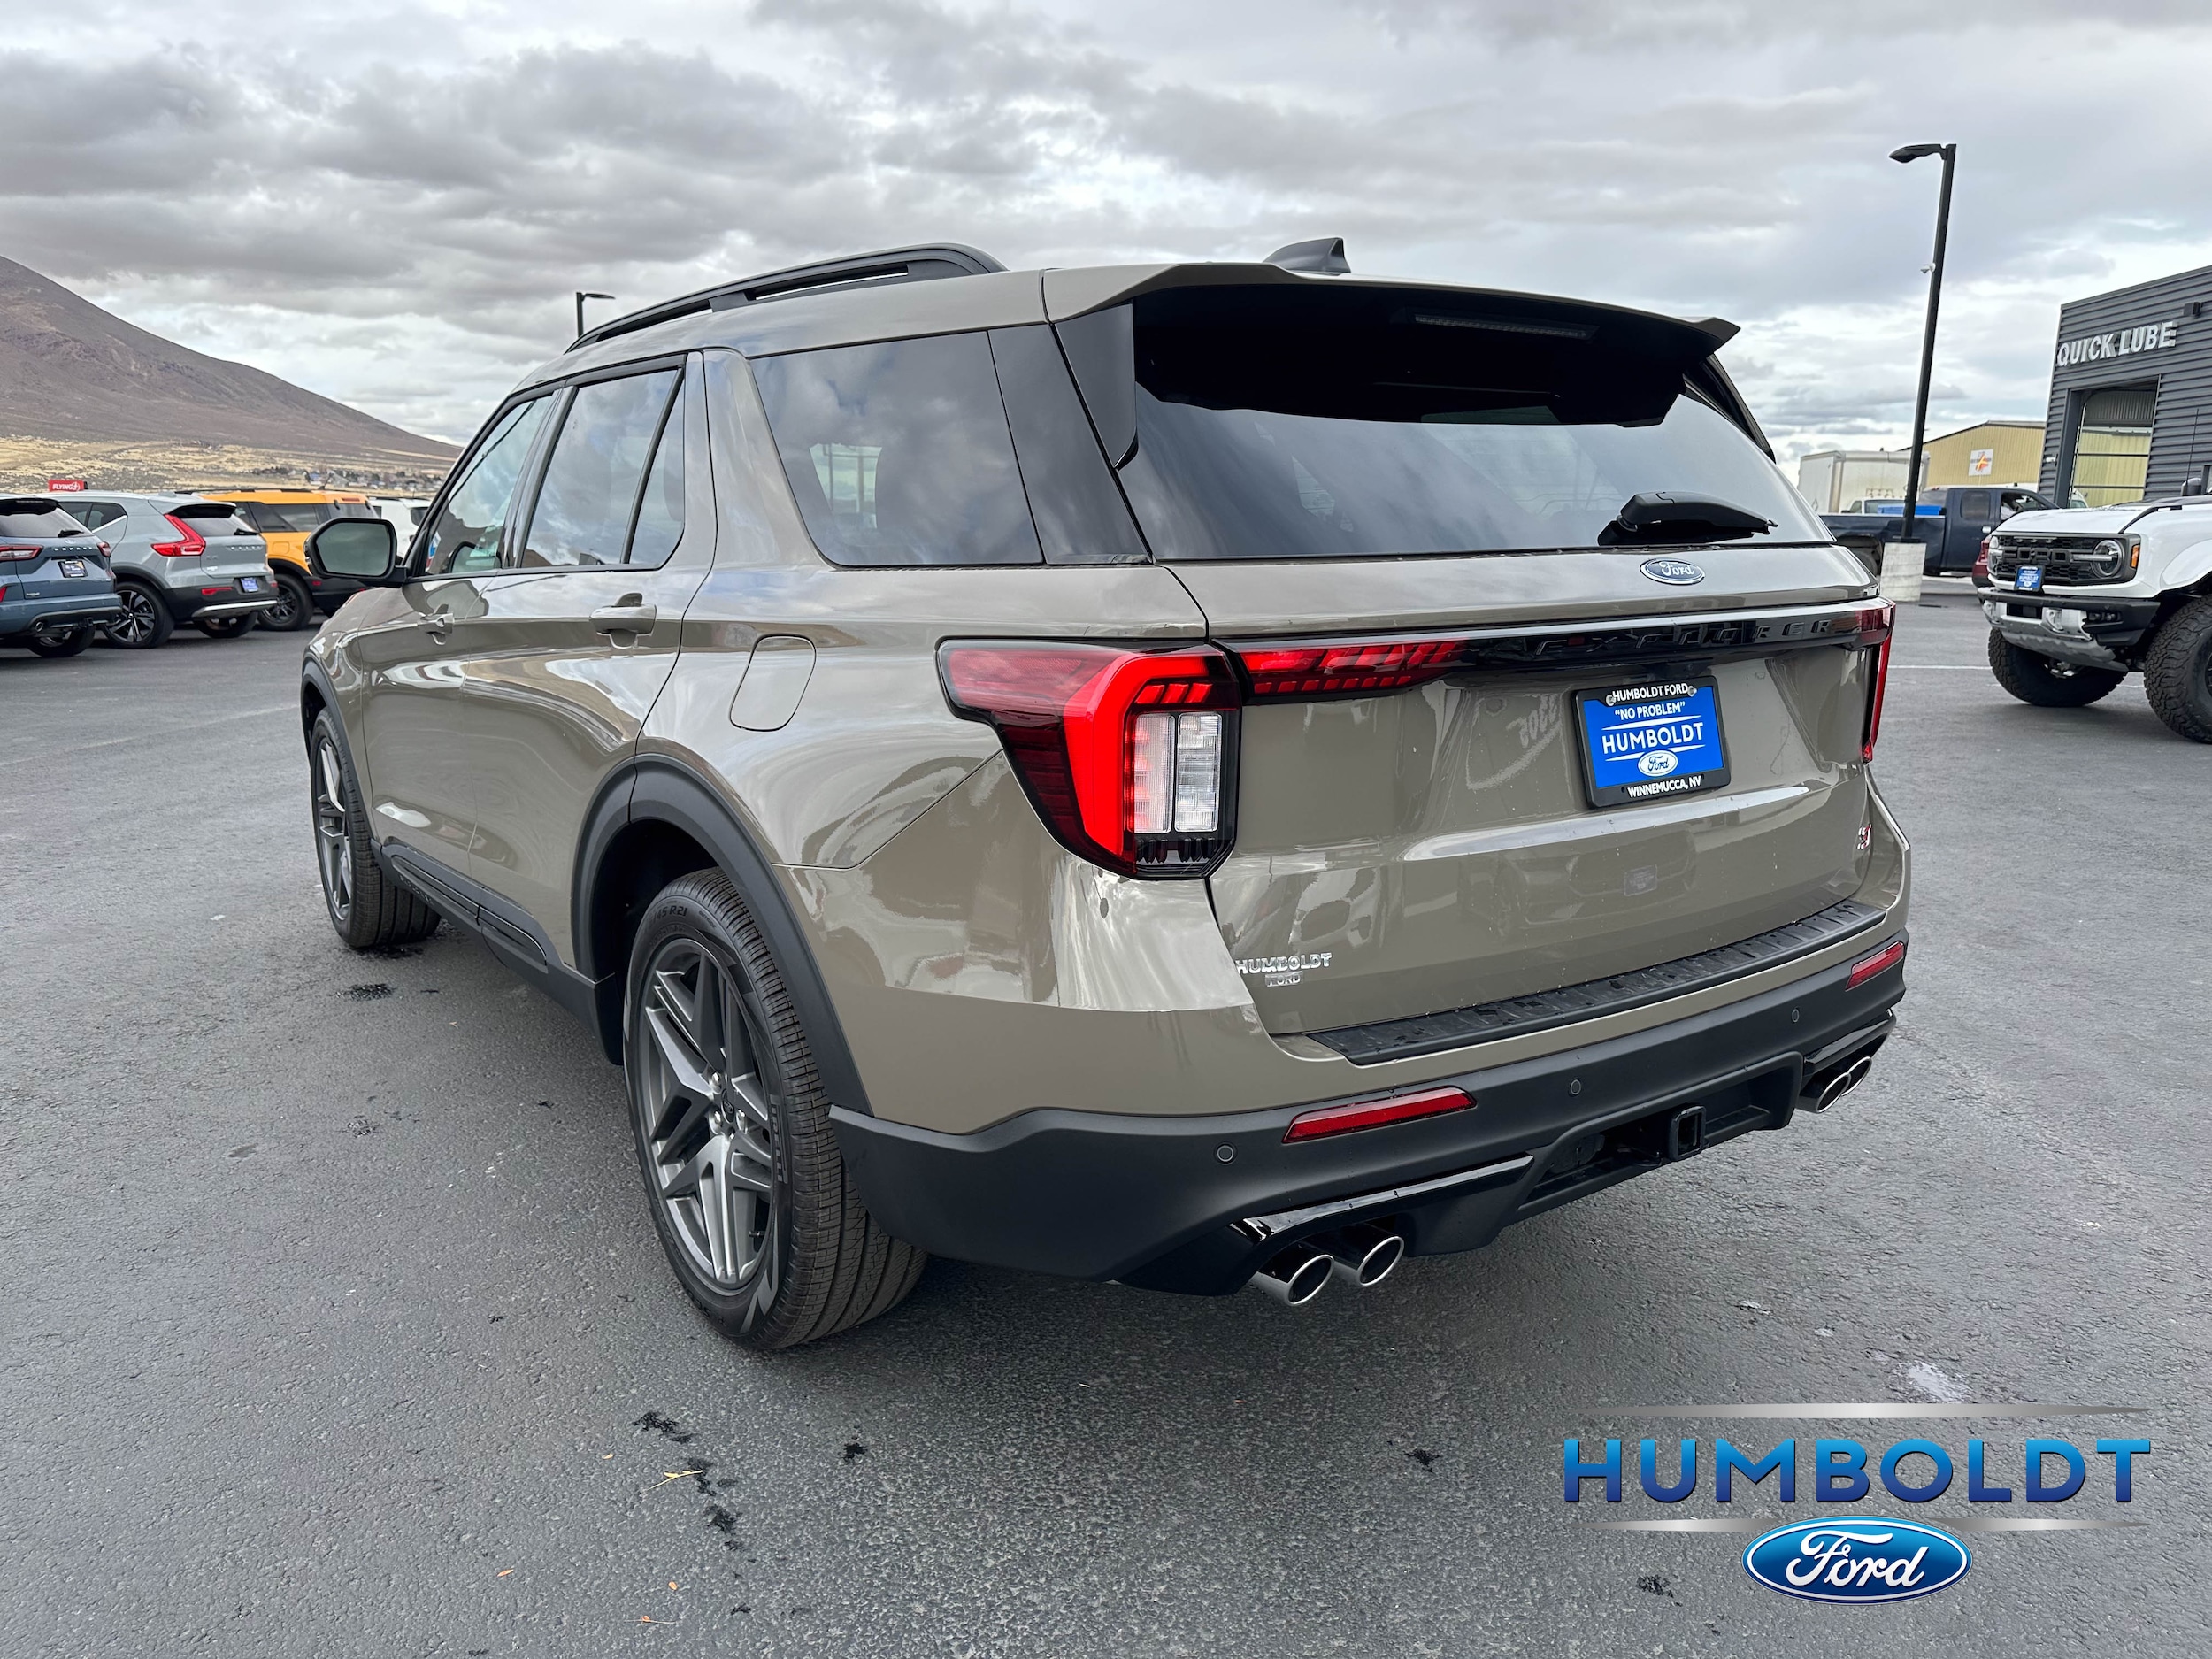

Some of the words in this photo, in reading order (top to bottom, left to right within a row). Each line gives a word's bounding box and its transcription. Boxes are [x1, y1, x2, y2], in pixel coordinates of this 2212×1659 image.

[2057, 333, 2116, 366] QUICK
[2118, 321, 2177, 356] LUBE
[1659, 561, 1694, 576] Ford
[1612, 685, 1663, 703] HUMBOLDT
[1664, 682, 1689, 695] FORD
[1601, 722, 1704, 754] HUMBOLDT
[1647, 756, 1670, 772] Ford
[1627, 779, 1689, 798] WINNEMUCCA,
[1689, 776, 1702, 787] NV
[1235, 952, 1332, 974] HUMBOLDT
[1268, 972, 1302, 986] FORD
